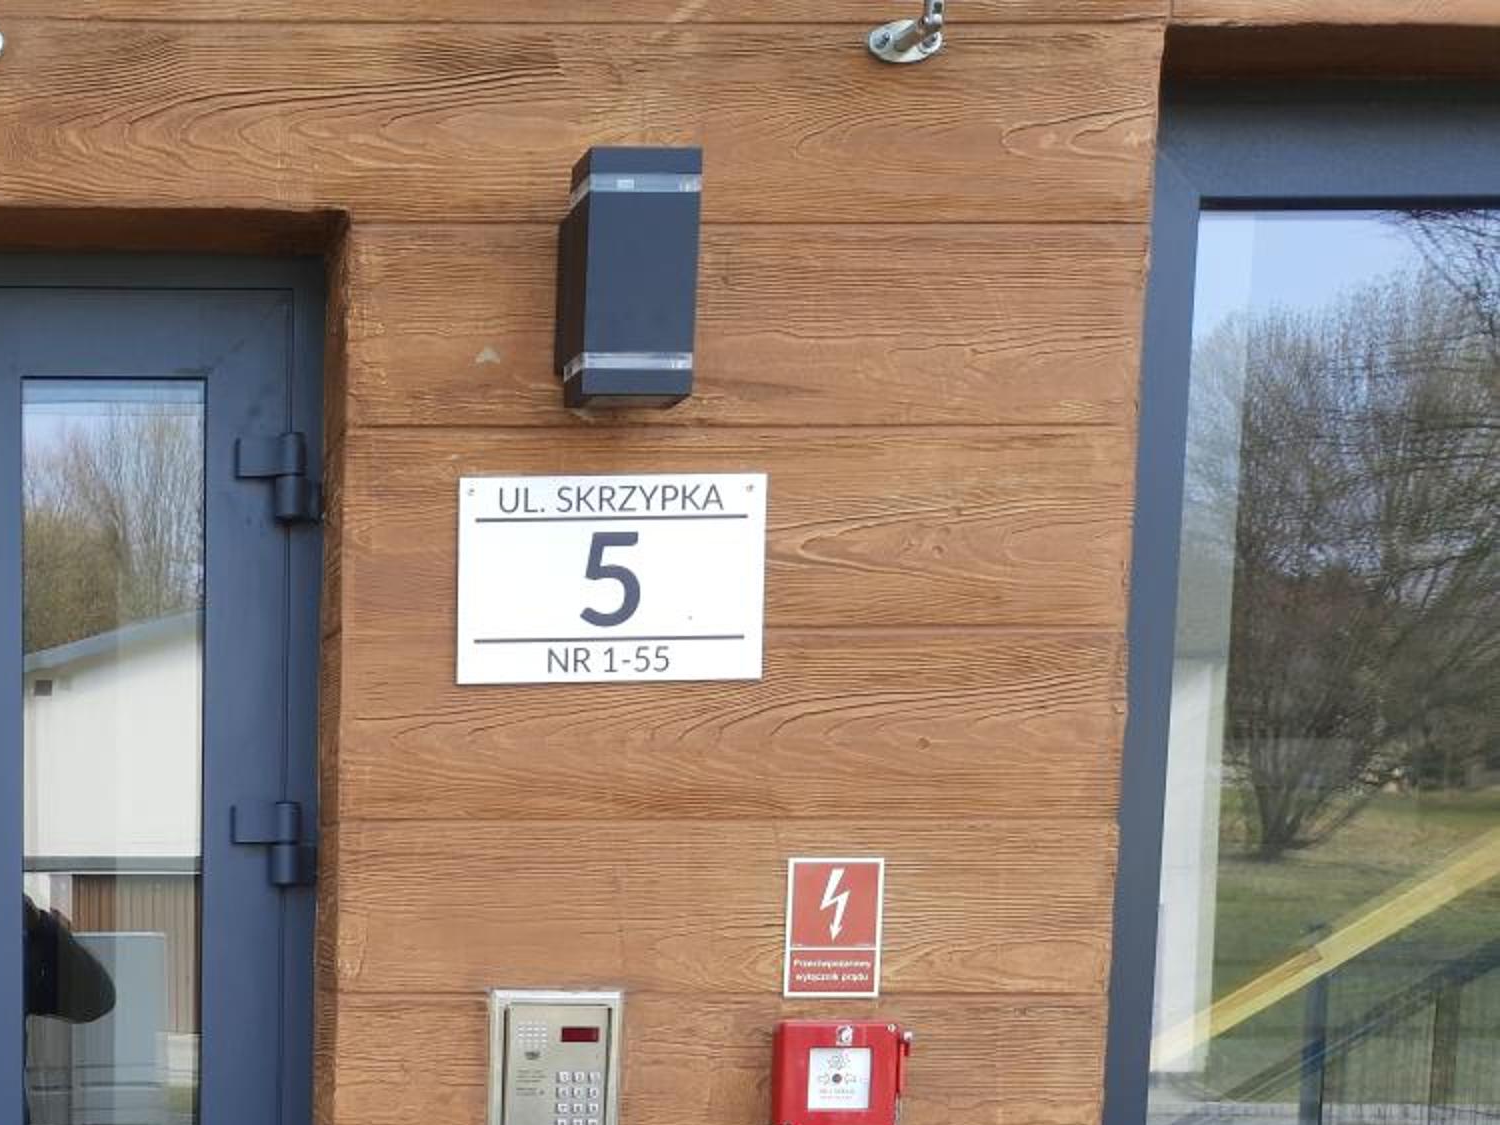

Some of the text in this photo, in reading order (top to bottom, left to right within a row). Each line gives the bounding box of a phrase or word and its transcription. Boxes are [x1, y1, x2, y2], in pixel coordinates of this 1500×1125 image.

[499, 484, 724, 513] UL. SKRZYPKA
[580, 531, 641, 627] 5
[547, 646, 671, 674] NR 1-55
